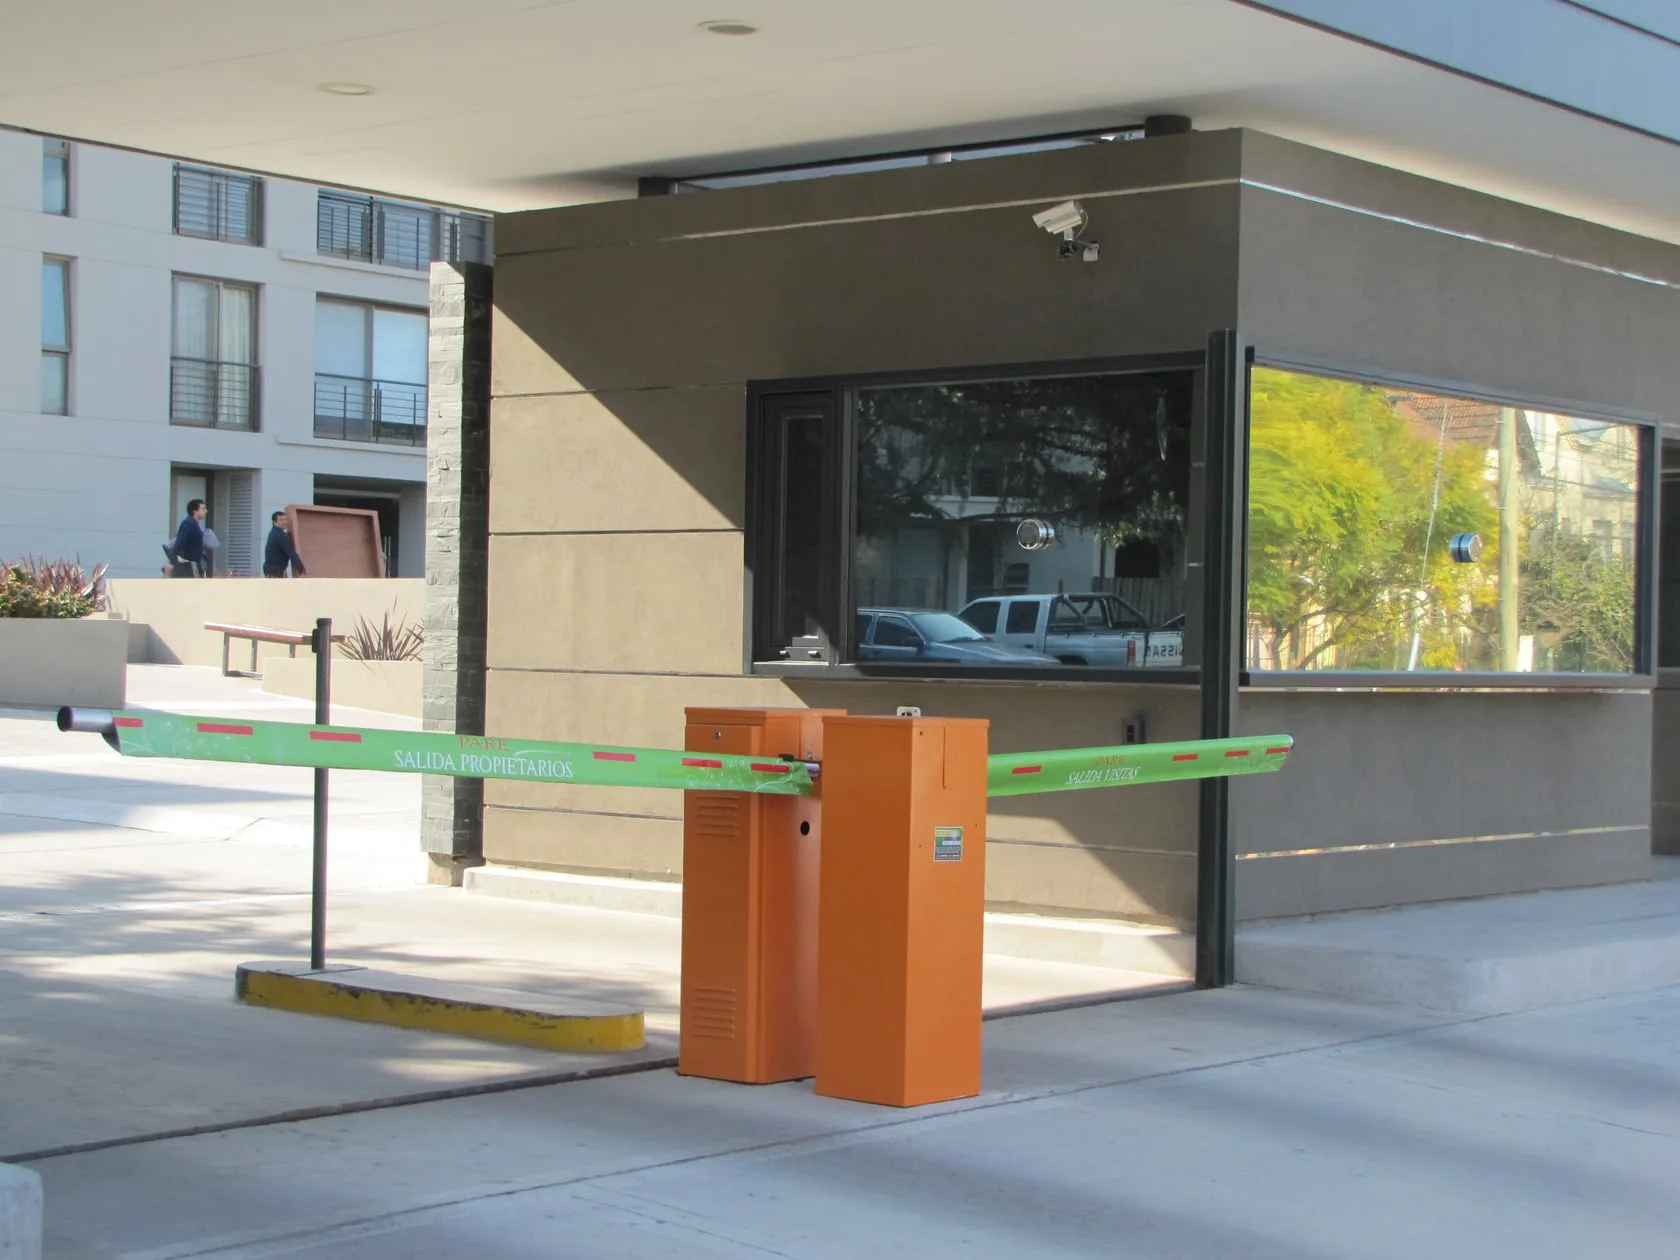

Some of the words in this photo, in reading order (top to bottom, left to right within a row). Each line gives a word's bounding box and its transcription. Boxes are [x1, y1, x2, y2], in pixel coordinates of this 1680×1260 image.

[458, 736, 509, 751] PARE
[395, 750, 457, 770] SALIDA
[460, 754, 574, 778] PROPIETARIOS
[1066, 770, 1103, 785] SALIDA
[1104, 766, 1141, 781] VISITAS
